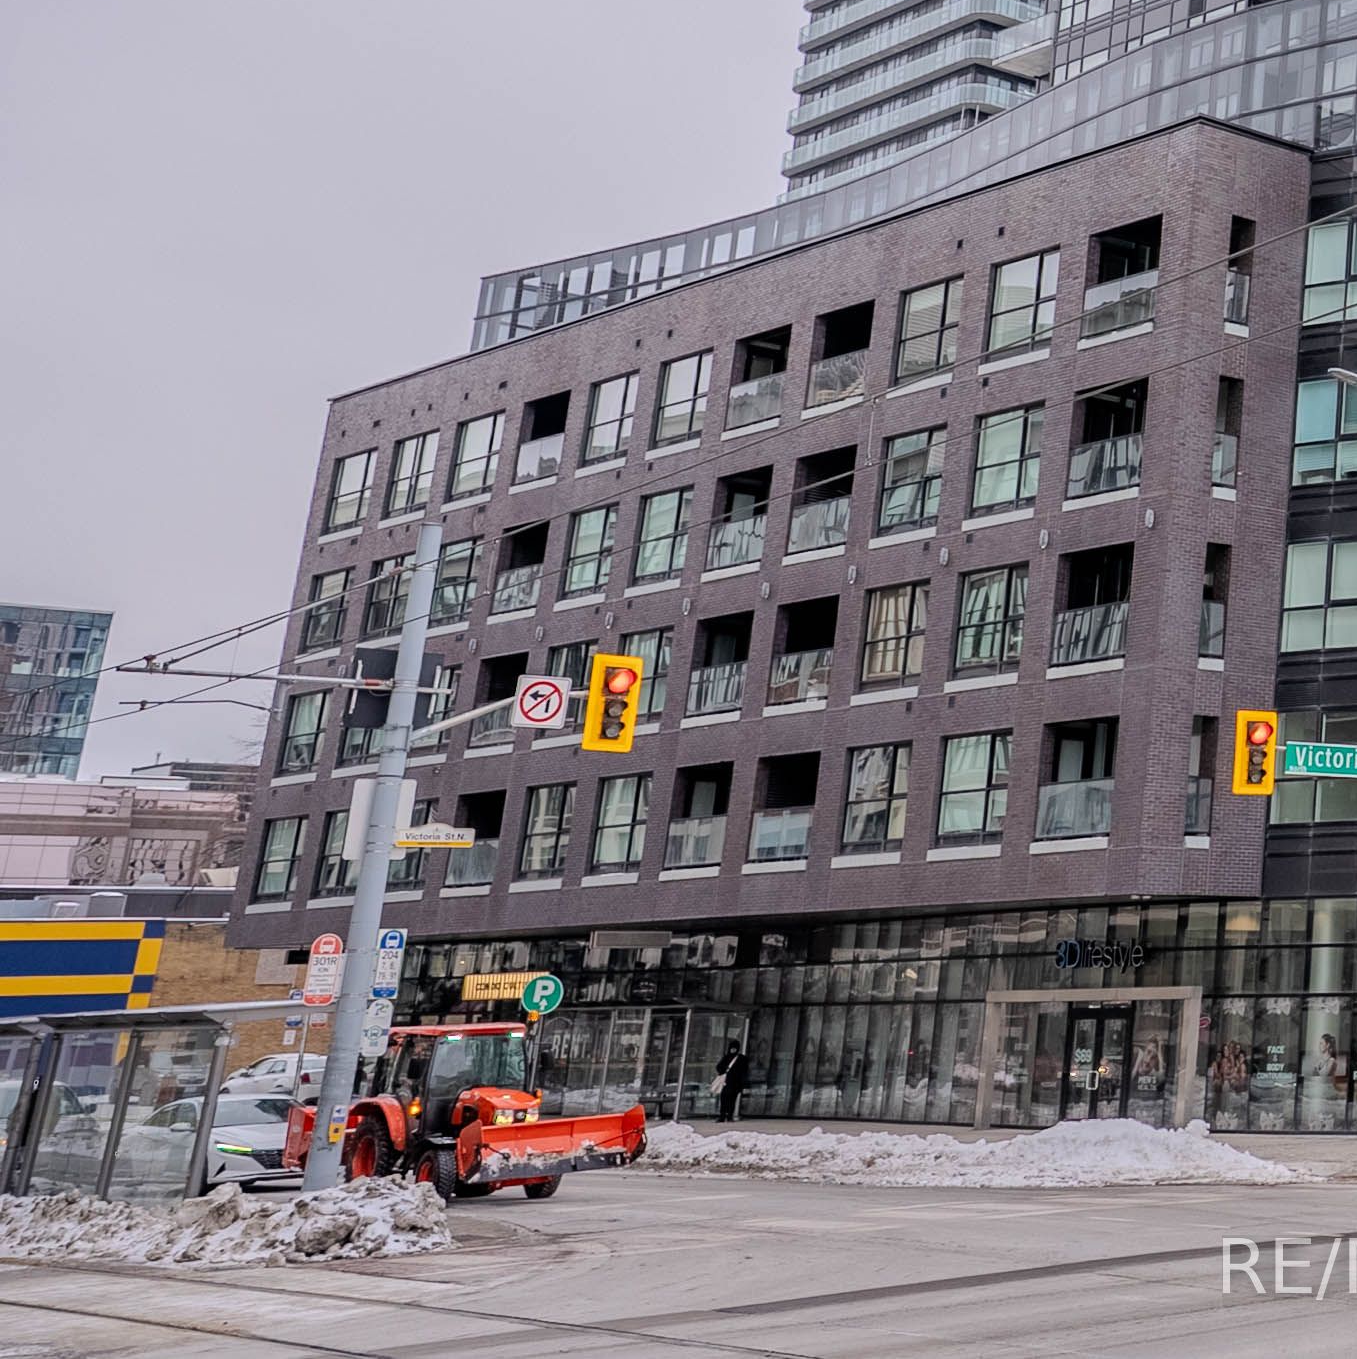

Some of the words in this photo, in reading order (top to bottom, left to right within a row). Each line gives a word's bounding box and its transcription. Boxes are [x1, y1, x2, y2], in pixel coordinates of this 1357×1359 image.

[405, 833, 441, 841] Victoria
[313, 956, 337, 966] 301R
[1267, 1045, 1286, 1054] FACE
[1266, 1063, 1285, 1072] BODY
